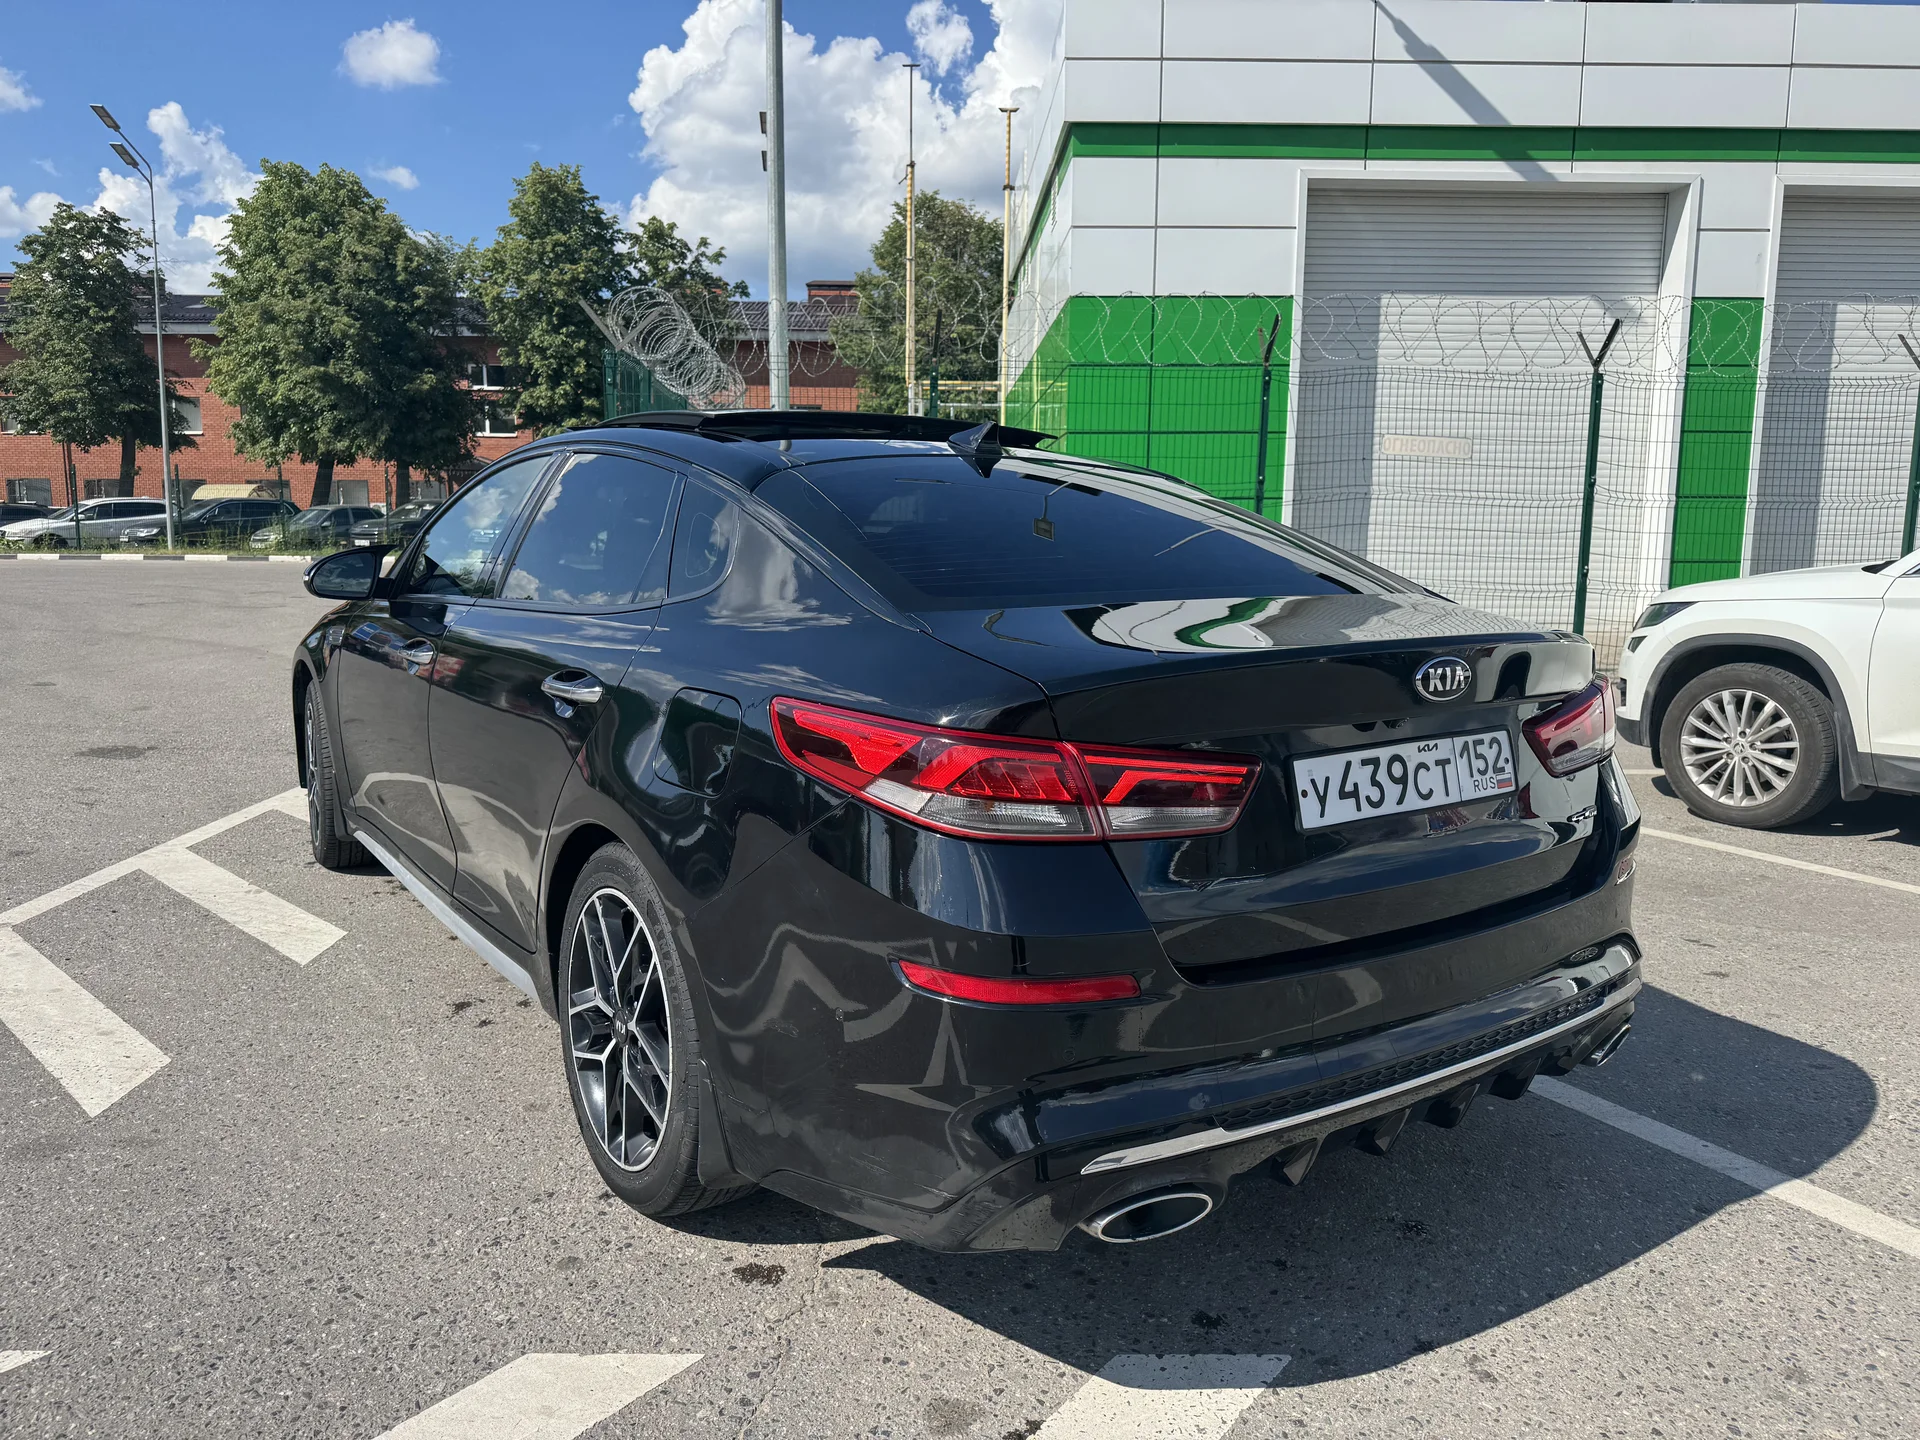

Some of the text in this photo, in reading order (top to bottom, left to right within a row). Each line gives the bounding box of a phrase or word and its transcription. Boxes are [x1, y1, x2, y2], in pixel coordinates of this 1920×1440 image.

[1383, 437, 1471, 455] ОГНЕОПАСНО
[1428, 666, 1465, 692] KIA
[1459, 736, 1506, 778] 152
[1473, 776, 1496, 793] RUS
